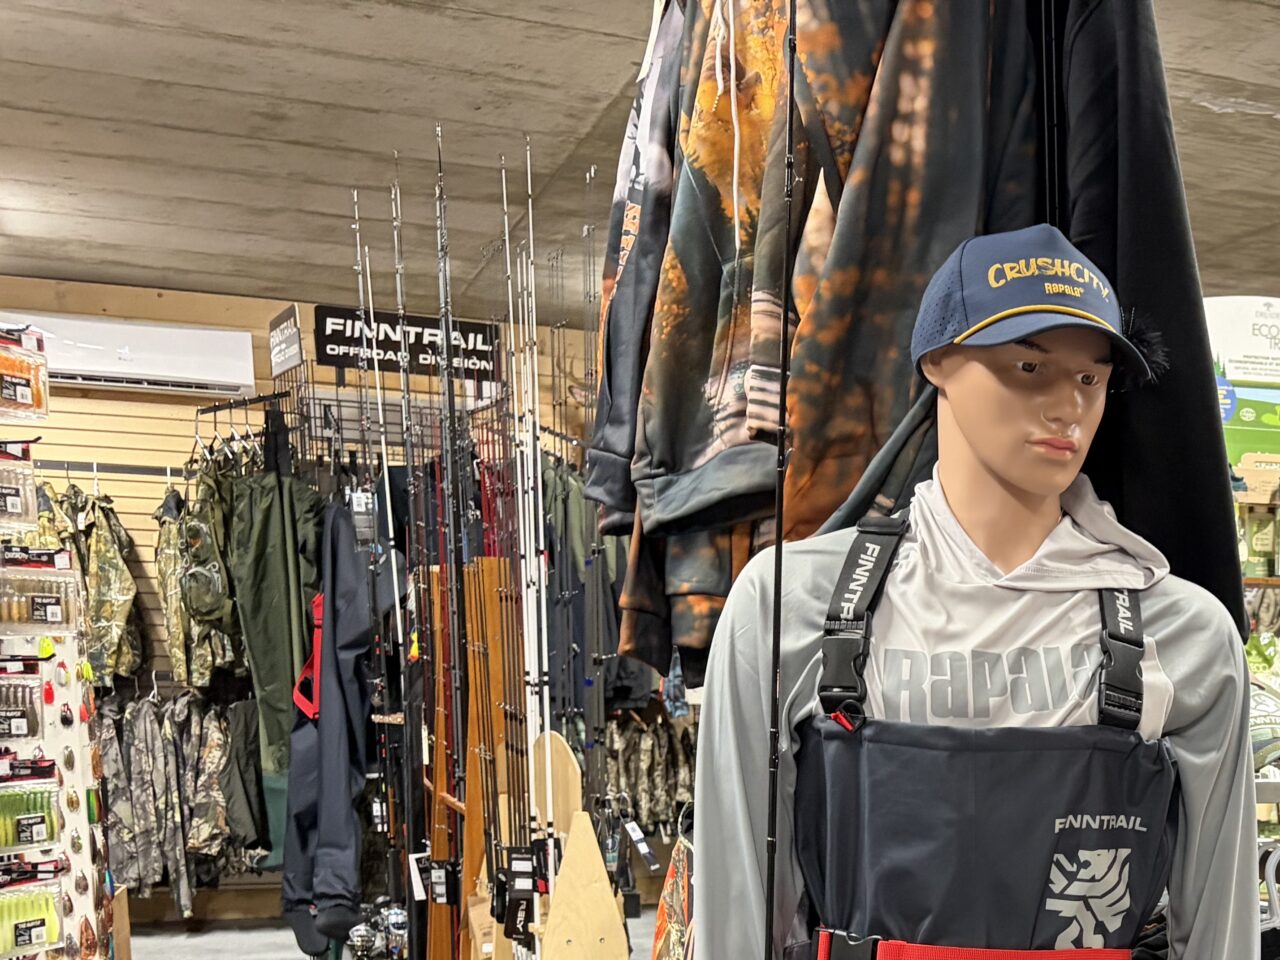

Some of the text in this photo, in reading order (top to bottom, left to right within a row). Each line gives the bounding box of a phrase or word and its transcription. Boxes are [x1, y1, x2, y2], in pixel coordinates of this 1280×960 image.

[987, 258, 1109, 299] CRUSHCITY
[325, 317, 493, 352] FINNTRAIL
[1252, 323, 1280, 338] ECO
[326, 343, 494, 372] OFFROAD DIVSION
[1054, 814, 1149, 834] FNNTRAIL
